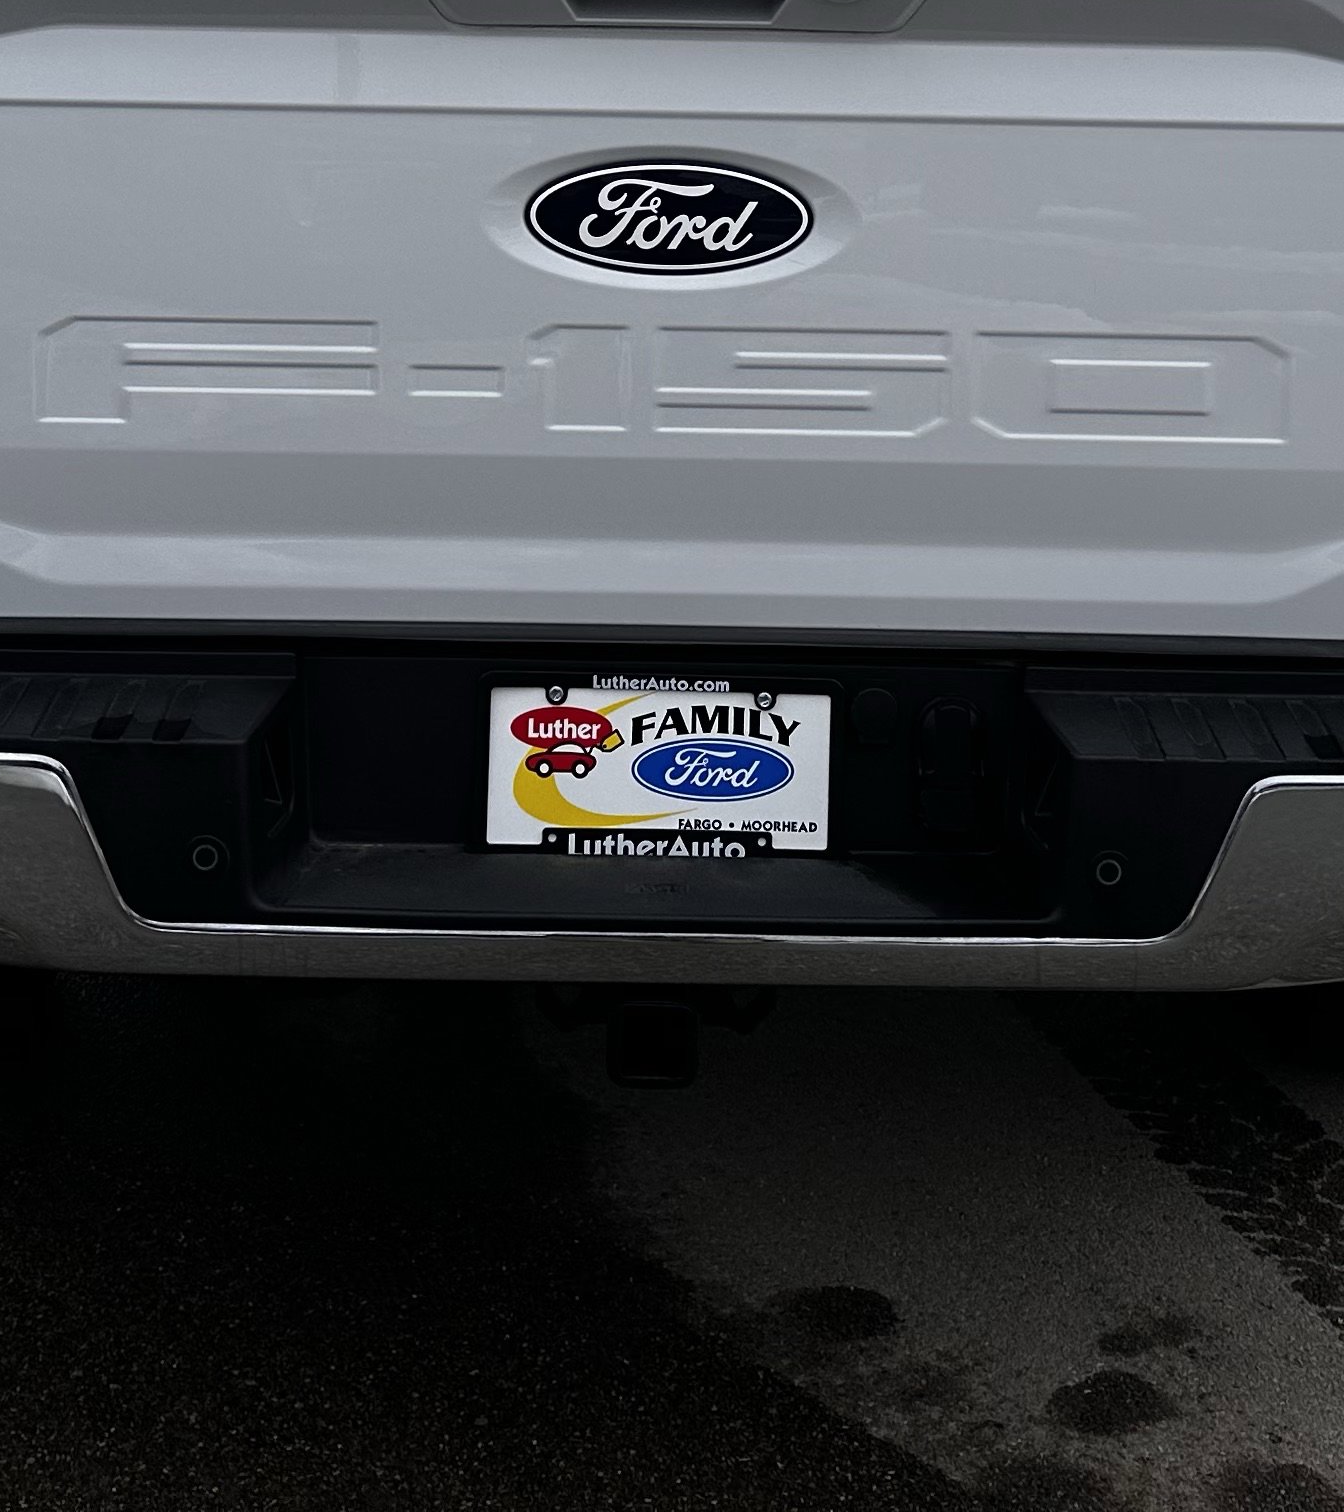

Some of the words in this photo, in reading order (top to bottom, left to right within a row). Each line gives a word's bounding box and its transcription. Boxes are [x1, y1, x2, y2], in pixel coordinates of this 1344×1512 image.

[579, 178, 758, 252] Ford
[33, 316, 1288, 445] F-150
[593, 675, 730, 693] LutherAuto.com
[527, 717, 601, 740] Luther
[631, 705, 801, 747] FAMILY
[665, 748, 760, 788] Ford
[678, 818, 723, 831] FARGO
[741, 819, 818, 833] MOORHEAD
[568, 833, 746, 858] LutherAuto
